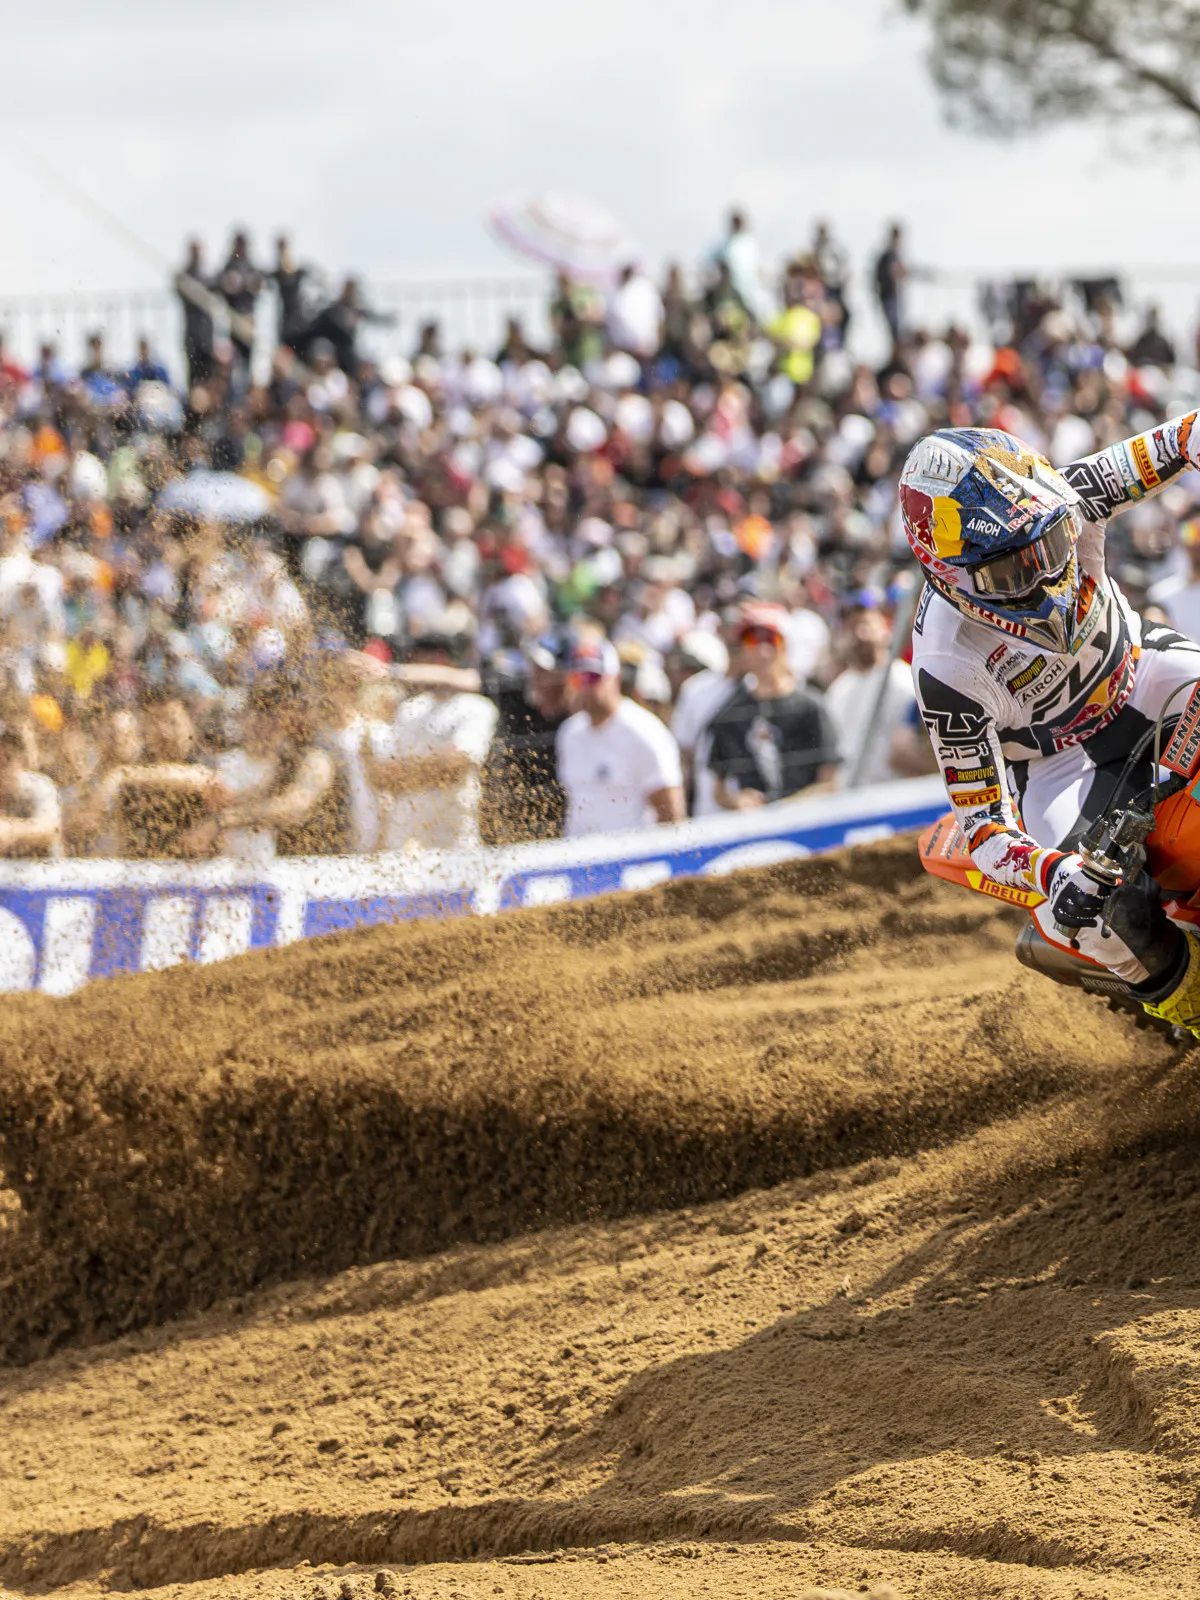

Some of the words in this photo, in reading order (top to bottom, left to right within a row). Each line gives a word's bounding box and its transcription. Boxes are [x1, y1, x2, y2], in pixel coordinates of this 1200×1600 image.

[966, 517, 1002, 537] AIROH
[1022, 663, 1062, 702] AIROH
[979, 873, 1032, 904] PIRELLI
